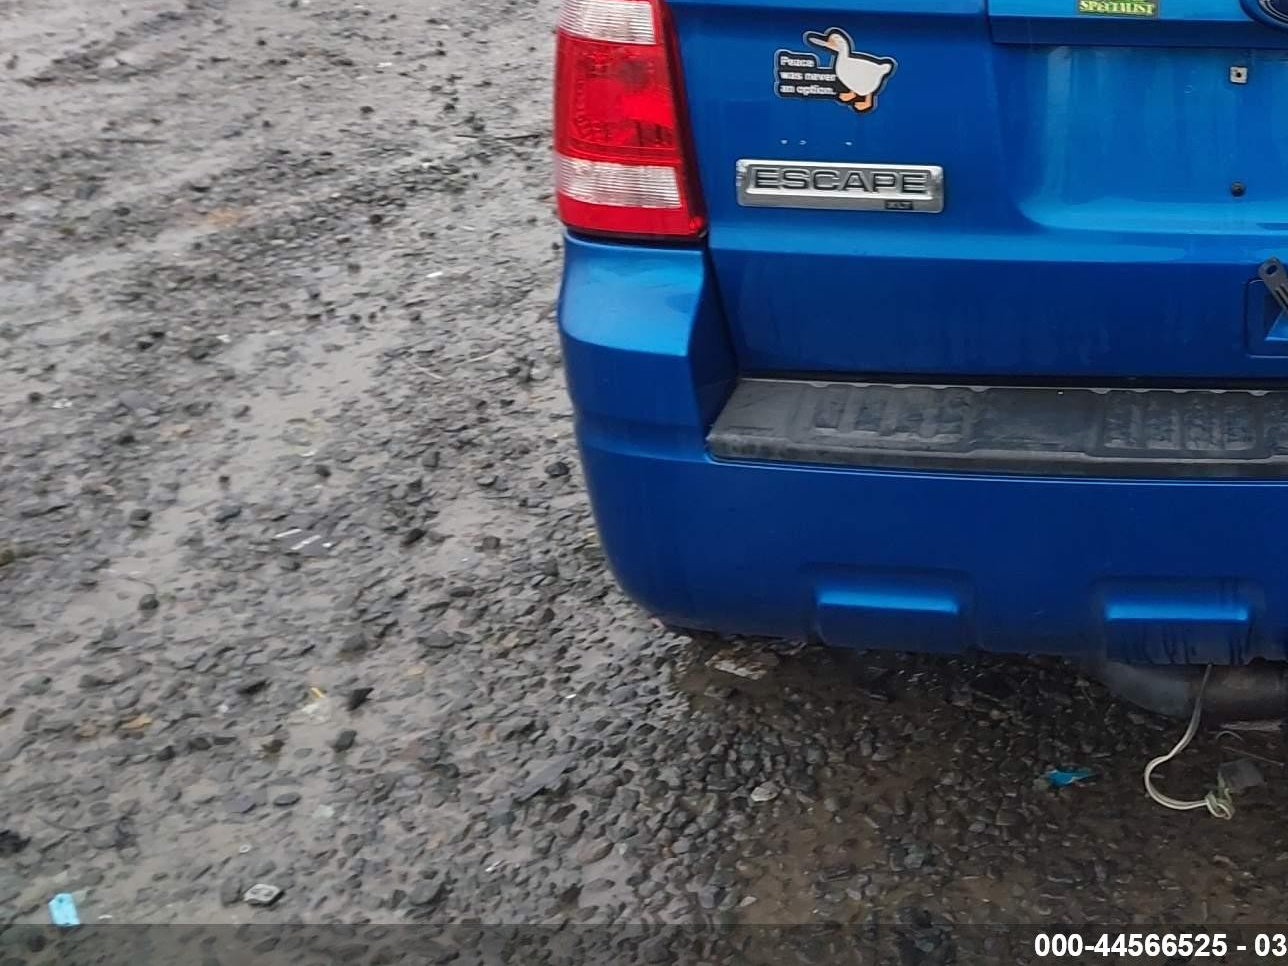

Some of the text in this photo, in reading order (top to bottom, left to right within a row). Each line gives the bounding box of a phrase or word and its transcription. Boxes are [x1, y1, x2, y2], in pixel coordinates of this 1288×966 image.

[1079, 0, 1155, 14] SPECIALIST
[780, 55, 815, 68] Peace
[780, 71, 837, 82] was never
[780, 85, 796, 93] an
[751, 165, 930, 195] ESCAPE
